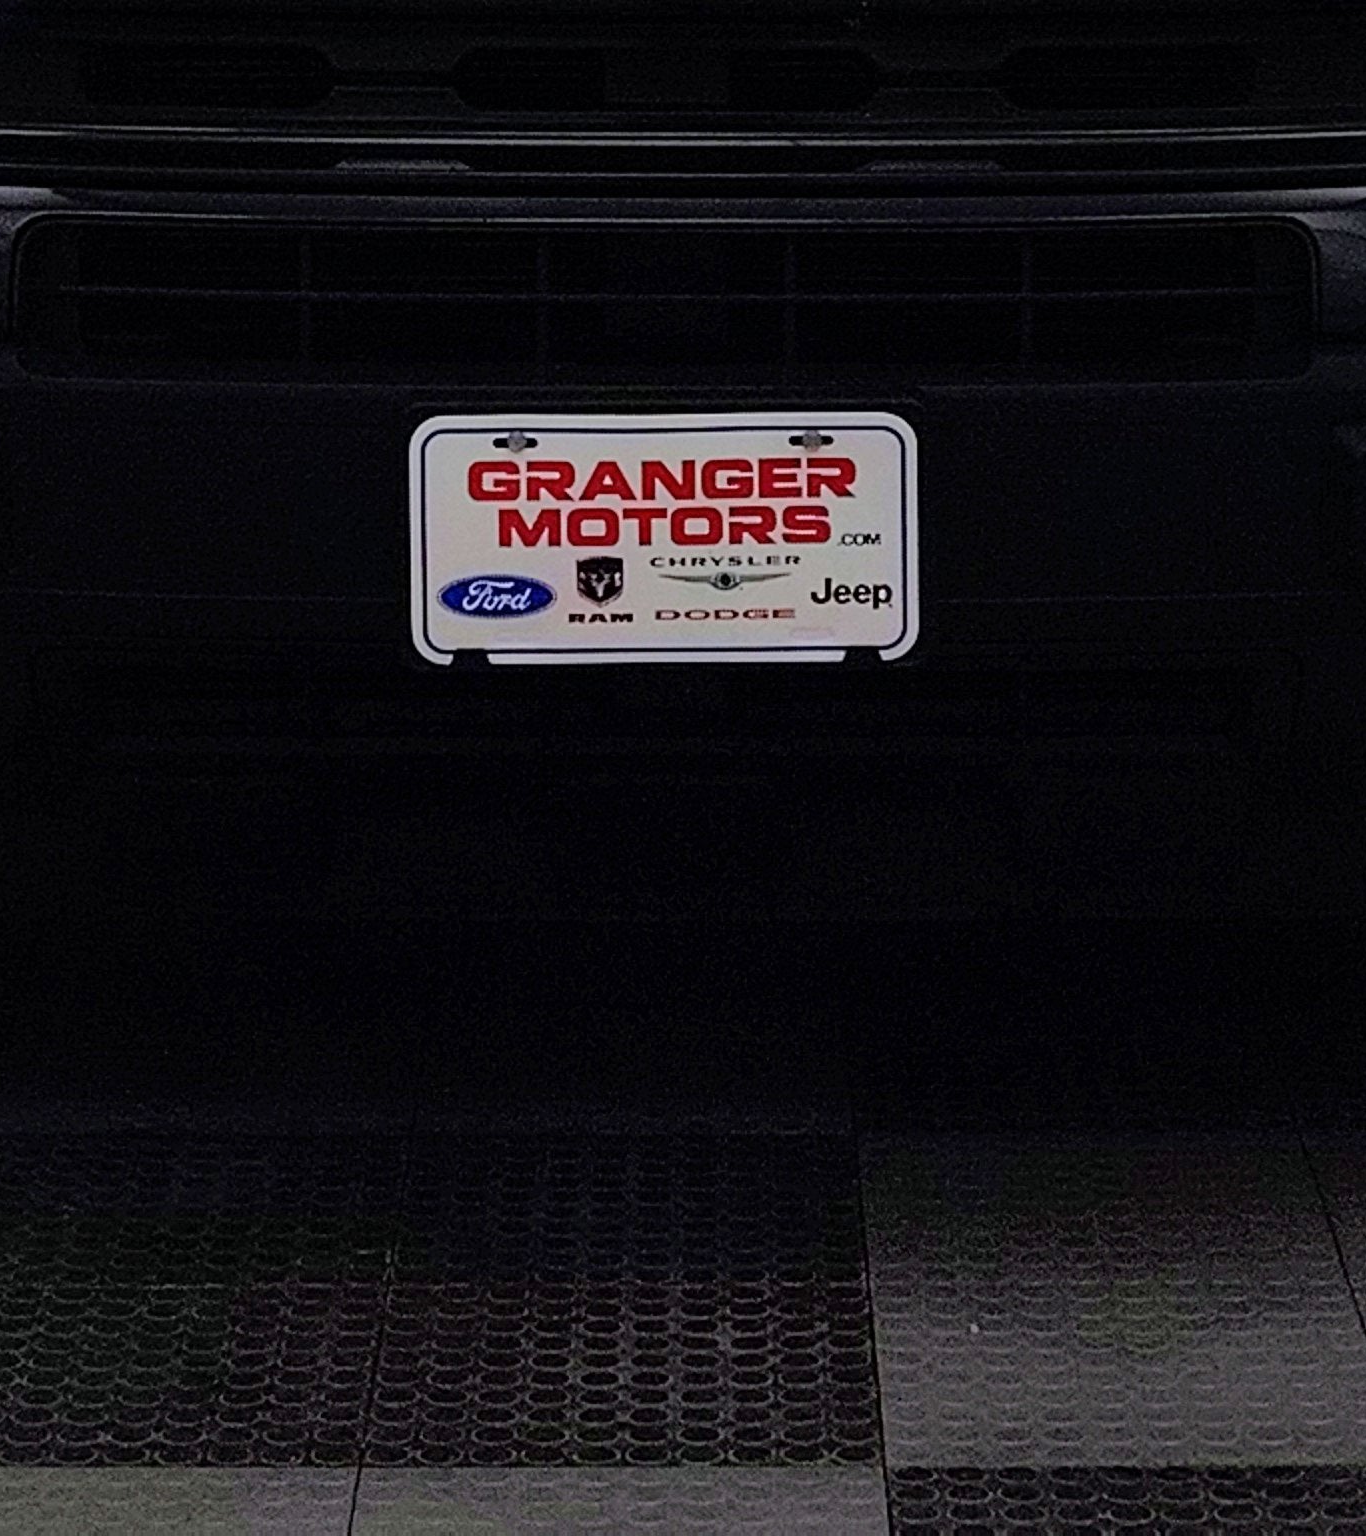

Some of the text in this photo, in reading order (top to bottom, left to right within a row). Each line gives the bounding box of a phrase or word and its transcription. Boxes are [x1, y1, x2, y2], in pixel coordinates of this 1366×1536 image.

[467, 457, 856, 502] GRANGER
[498, 505, 831, 547] MOTORS
[649, 554, 802, 567] CHRYSLER
[461, 579, 532, 611] Ford
[810, 577, 893, 610] Jeep
[568, 613, 634, 623] RAM
[655, 608, 796, 620] DODGE
